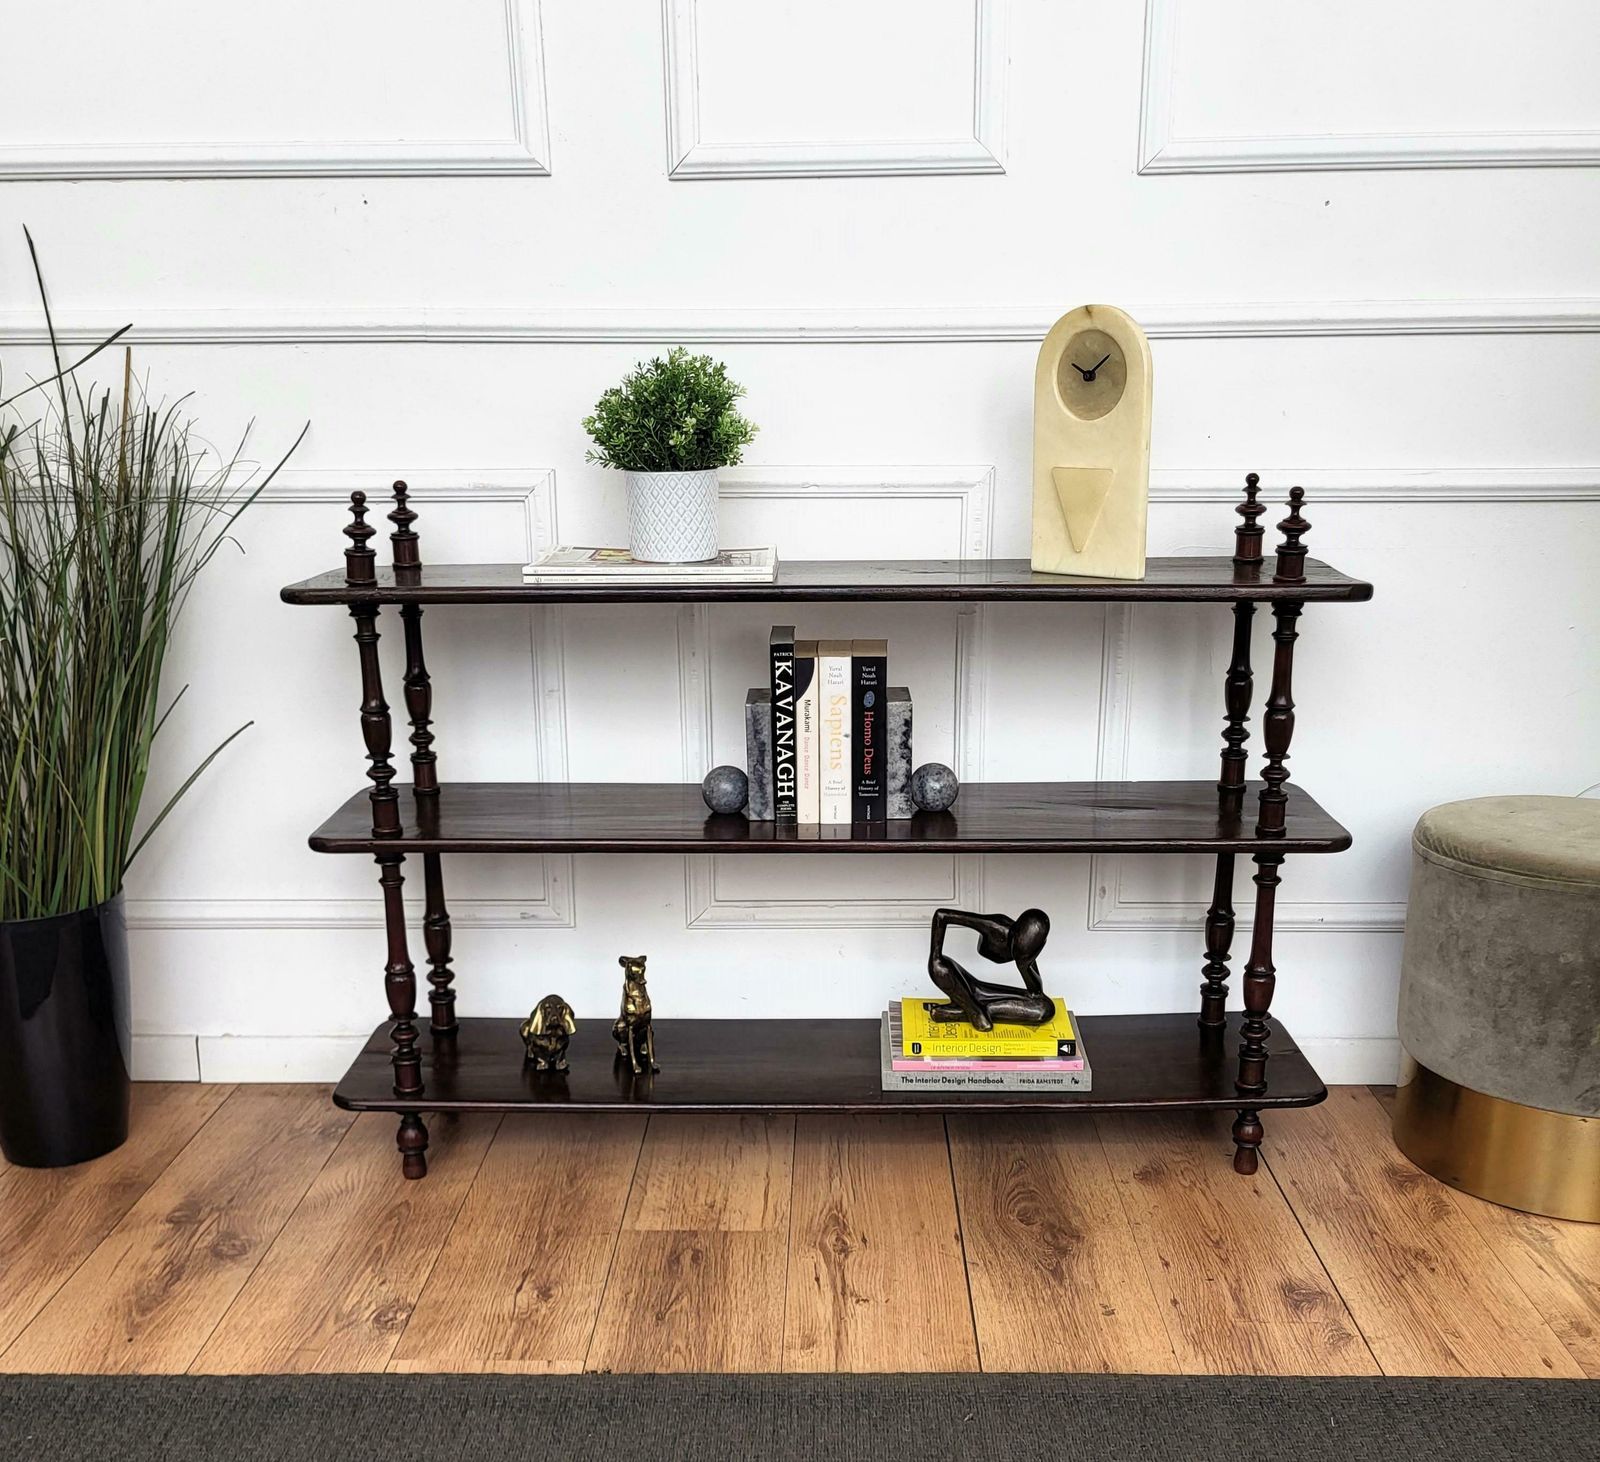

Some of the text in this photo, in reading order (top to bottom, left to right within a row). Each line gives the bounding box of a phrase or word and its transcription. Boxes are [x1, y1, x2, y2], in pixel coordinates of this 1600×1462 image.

[775, 660, 795, 798] KAVANAGH
[825, 694, 848, 770] Sapiens
[864, 711, 874, 775] Homo Deus
[915, 1076, 941, 1084] Interior
[942, 1076, 966, 1085] Design
[967, 1076, 1004, 1084] Handbook
[932, 1043, 1001, 1054] Interior Design
